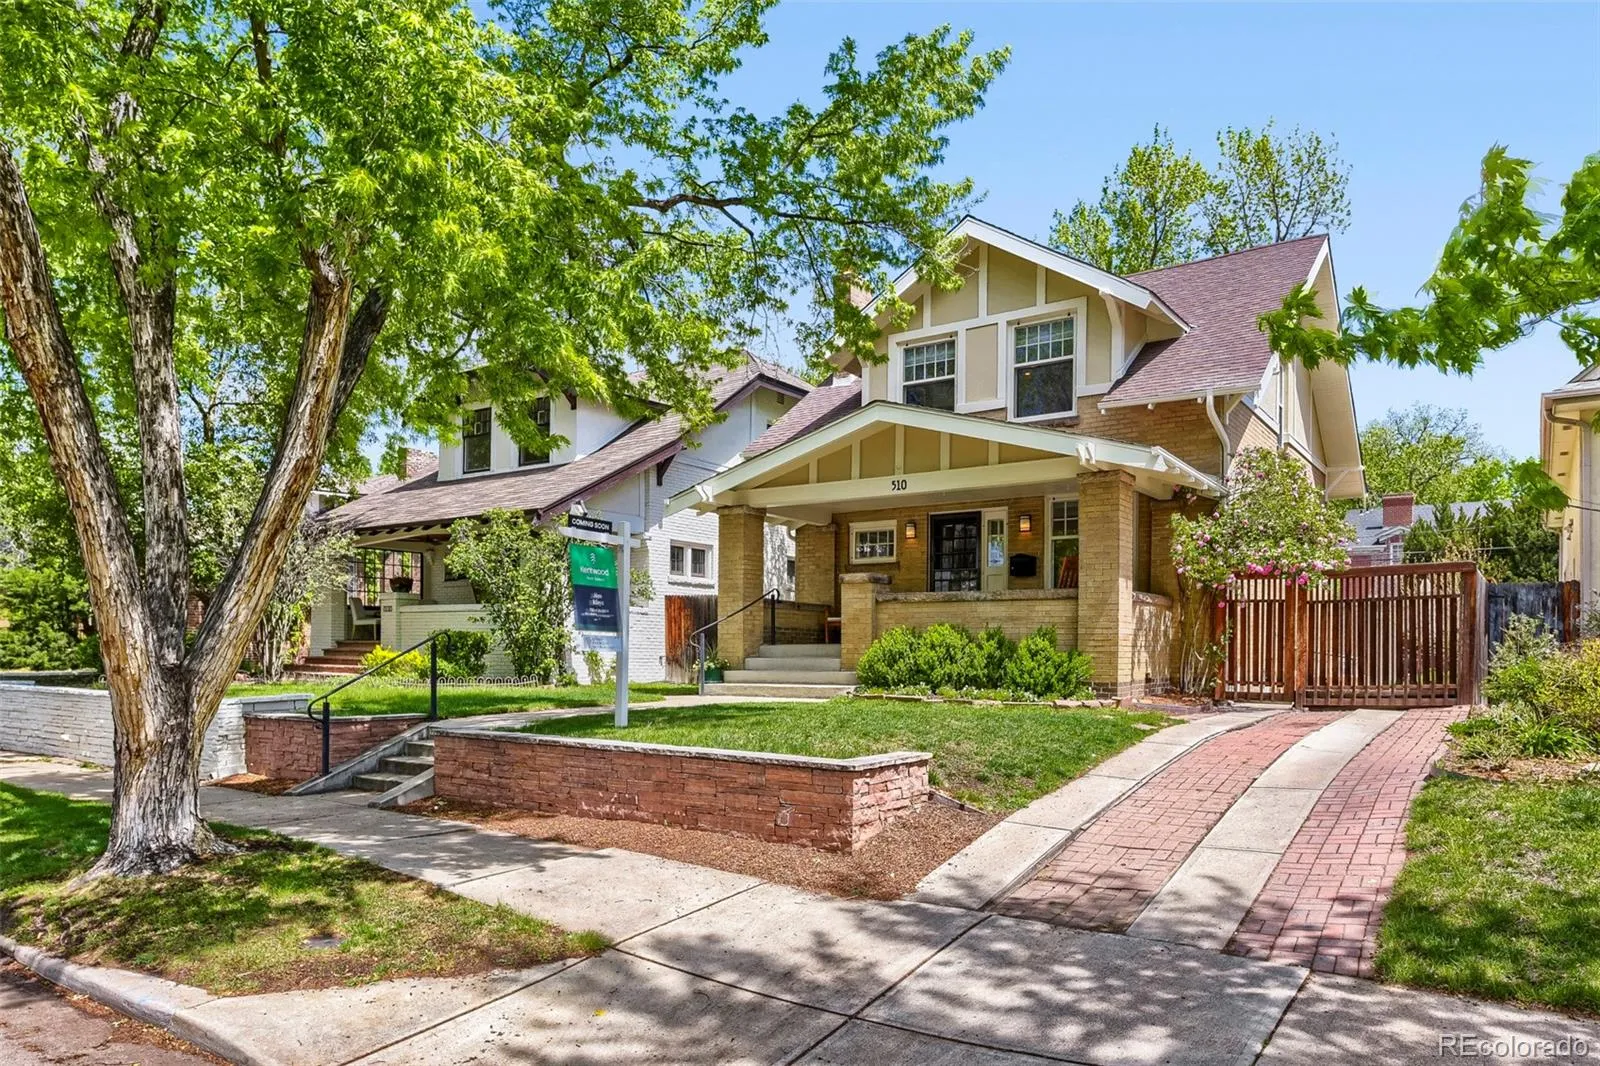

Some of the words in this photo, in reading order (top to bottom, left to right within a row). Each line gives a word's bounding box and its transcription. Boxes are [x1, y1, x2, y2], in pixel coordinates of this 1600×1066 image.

[891, 479, 908, 491] 510
[571, 518, 594, 528] COMING
[594, 522, 610, 530] SOON
